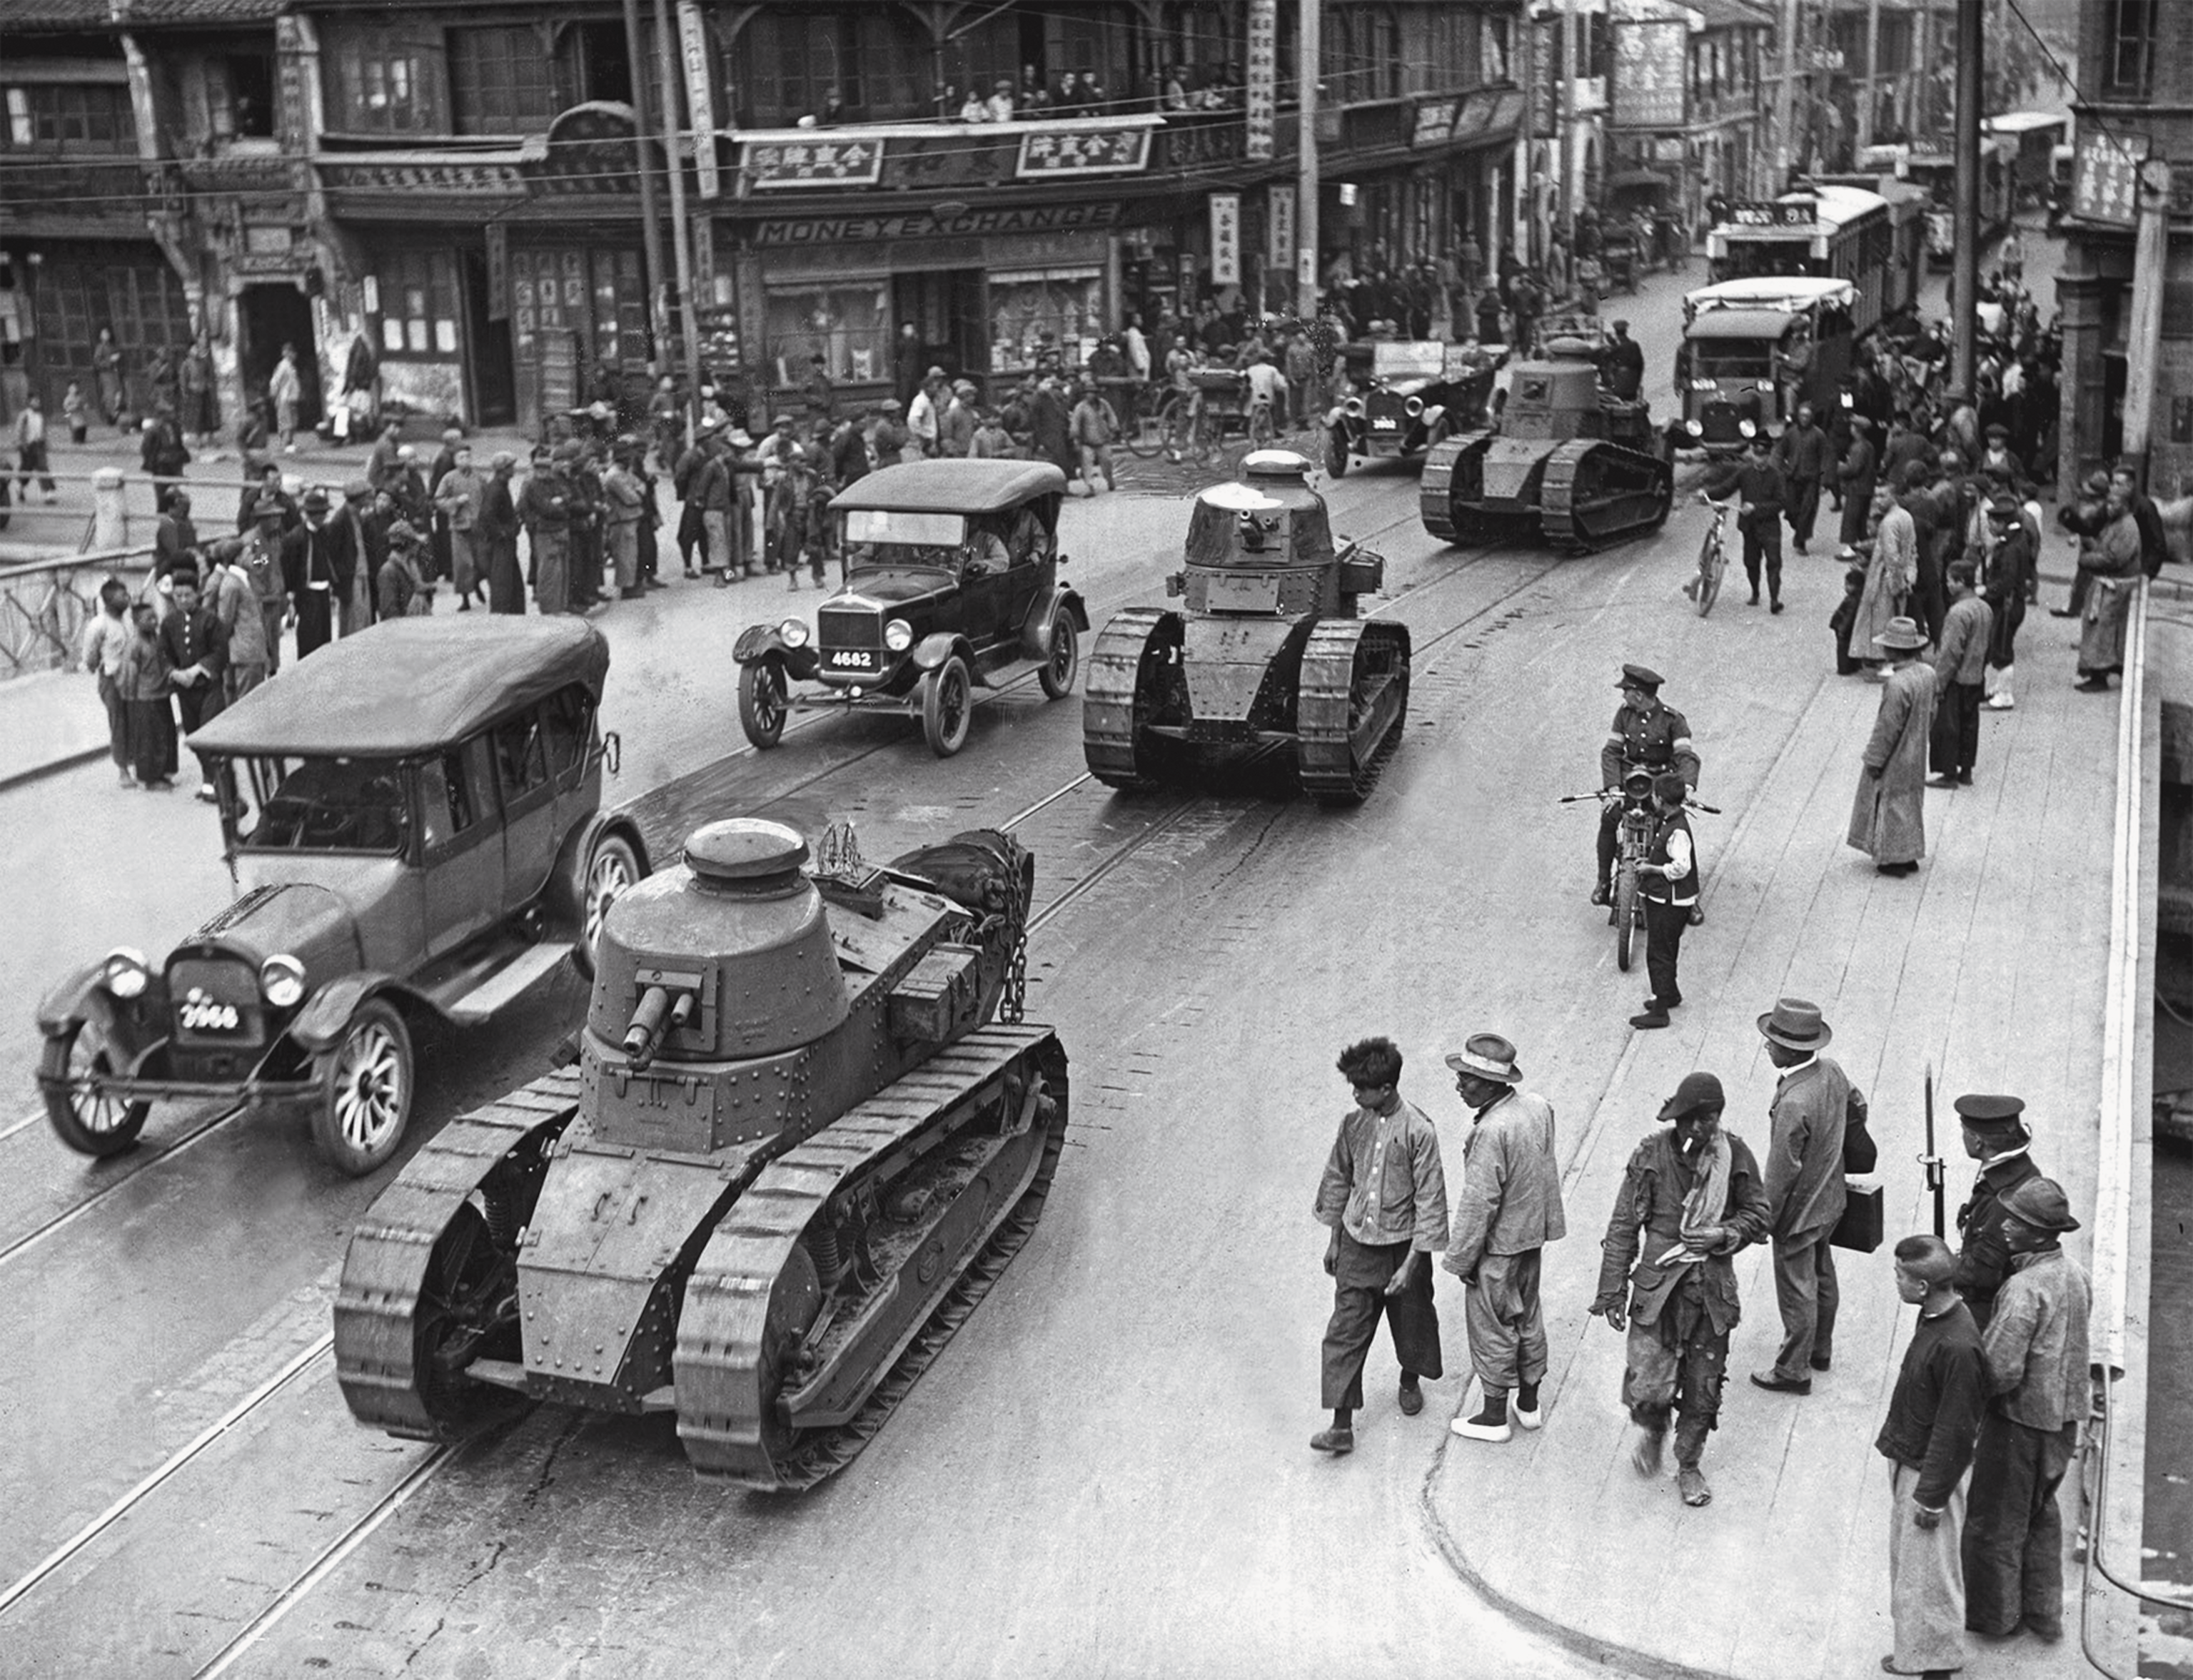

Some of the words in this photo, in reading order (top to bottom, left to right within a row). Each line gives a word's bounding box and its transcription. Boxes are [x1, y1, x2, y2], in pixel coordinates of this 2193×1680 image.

[763, 216, 890, 242] MONEY
[899, 204, 1118, 235] EXCHANGE
[832, 651, 872, 667] 4682
